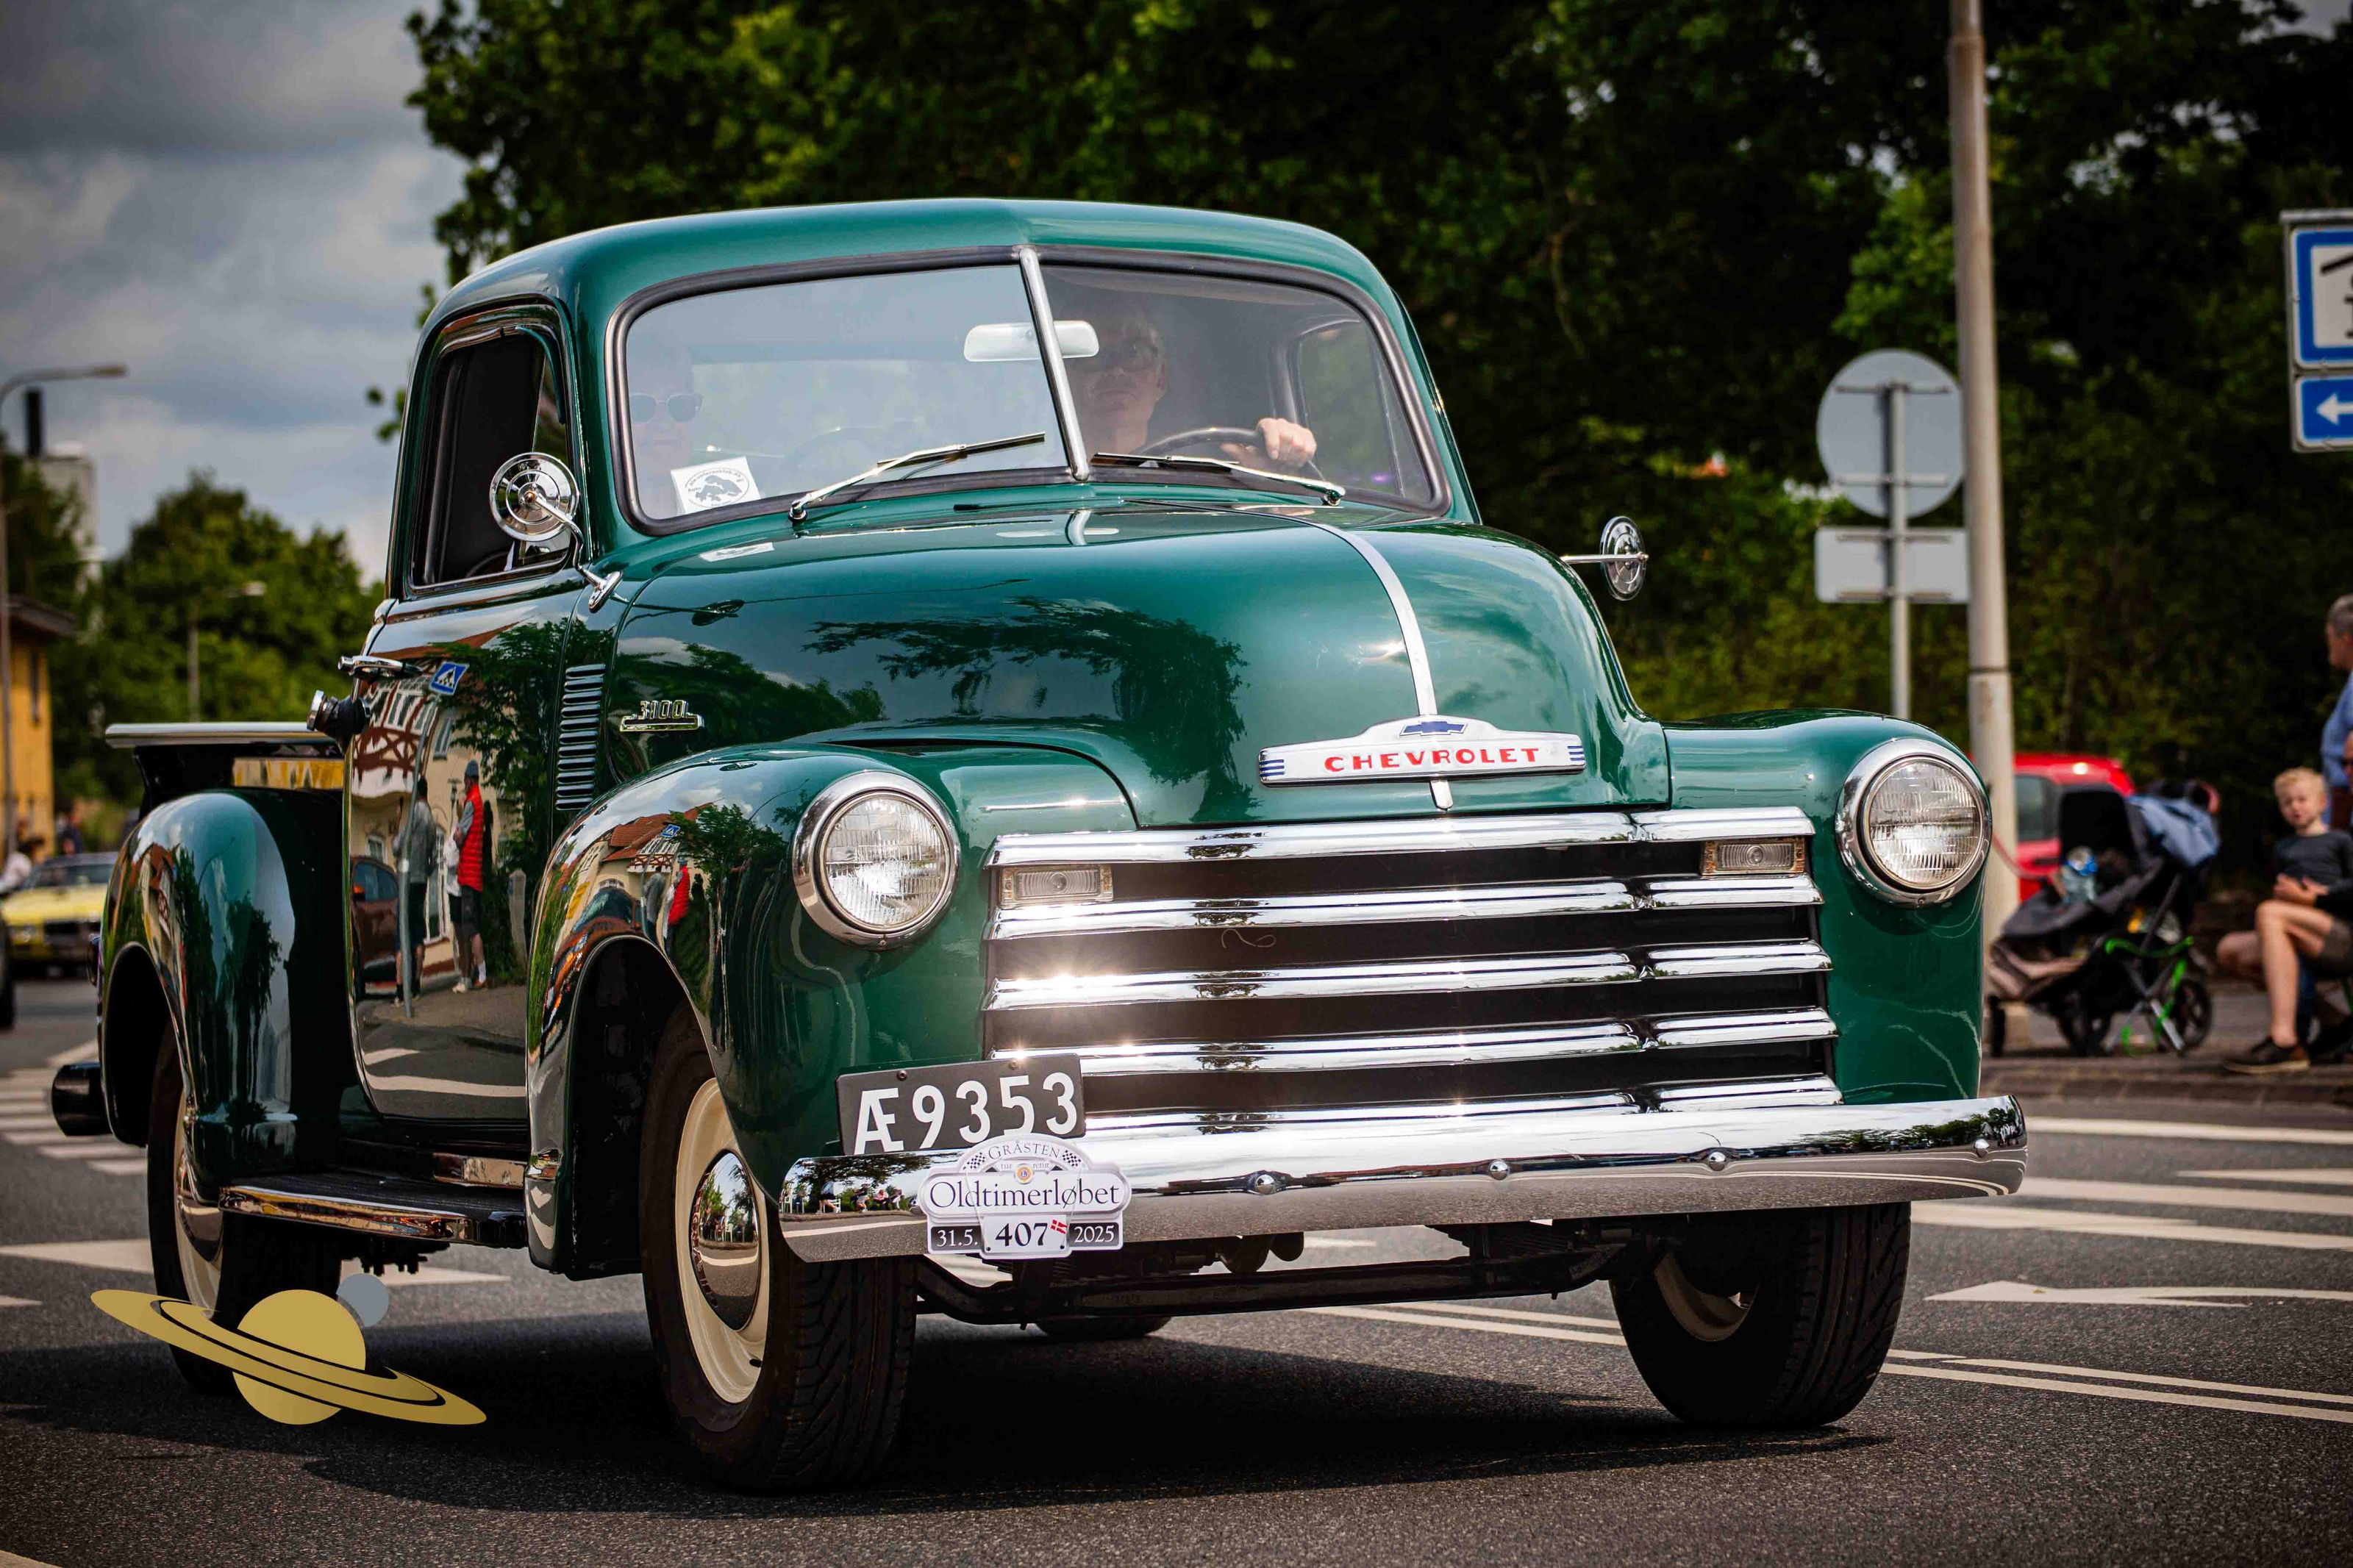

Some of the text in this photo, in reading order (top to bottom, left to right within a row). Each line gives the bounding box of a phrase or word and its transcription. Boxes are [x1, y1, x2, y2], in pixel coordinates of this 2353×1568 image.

[638, 700, 688, 720] 3100
[1324, 748, 1539, 772] CHEVROLET
[988, 1140, 1060, 1160] GRÅSTEN
[929, 1178, 1121, 1209] Oldtimerløbet
[936, 1222, 1115, 1247] 31.5. 407 2025
